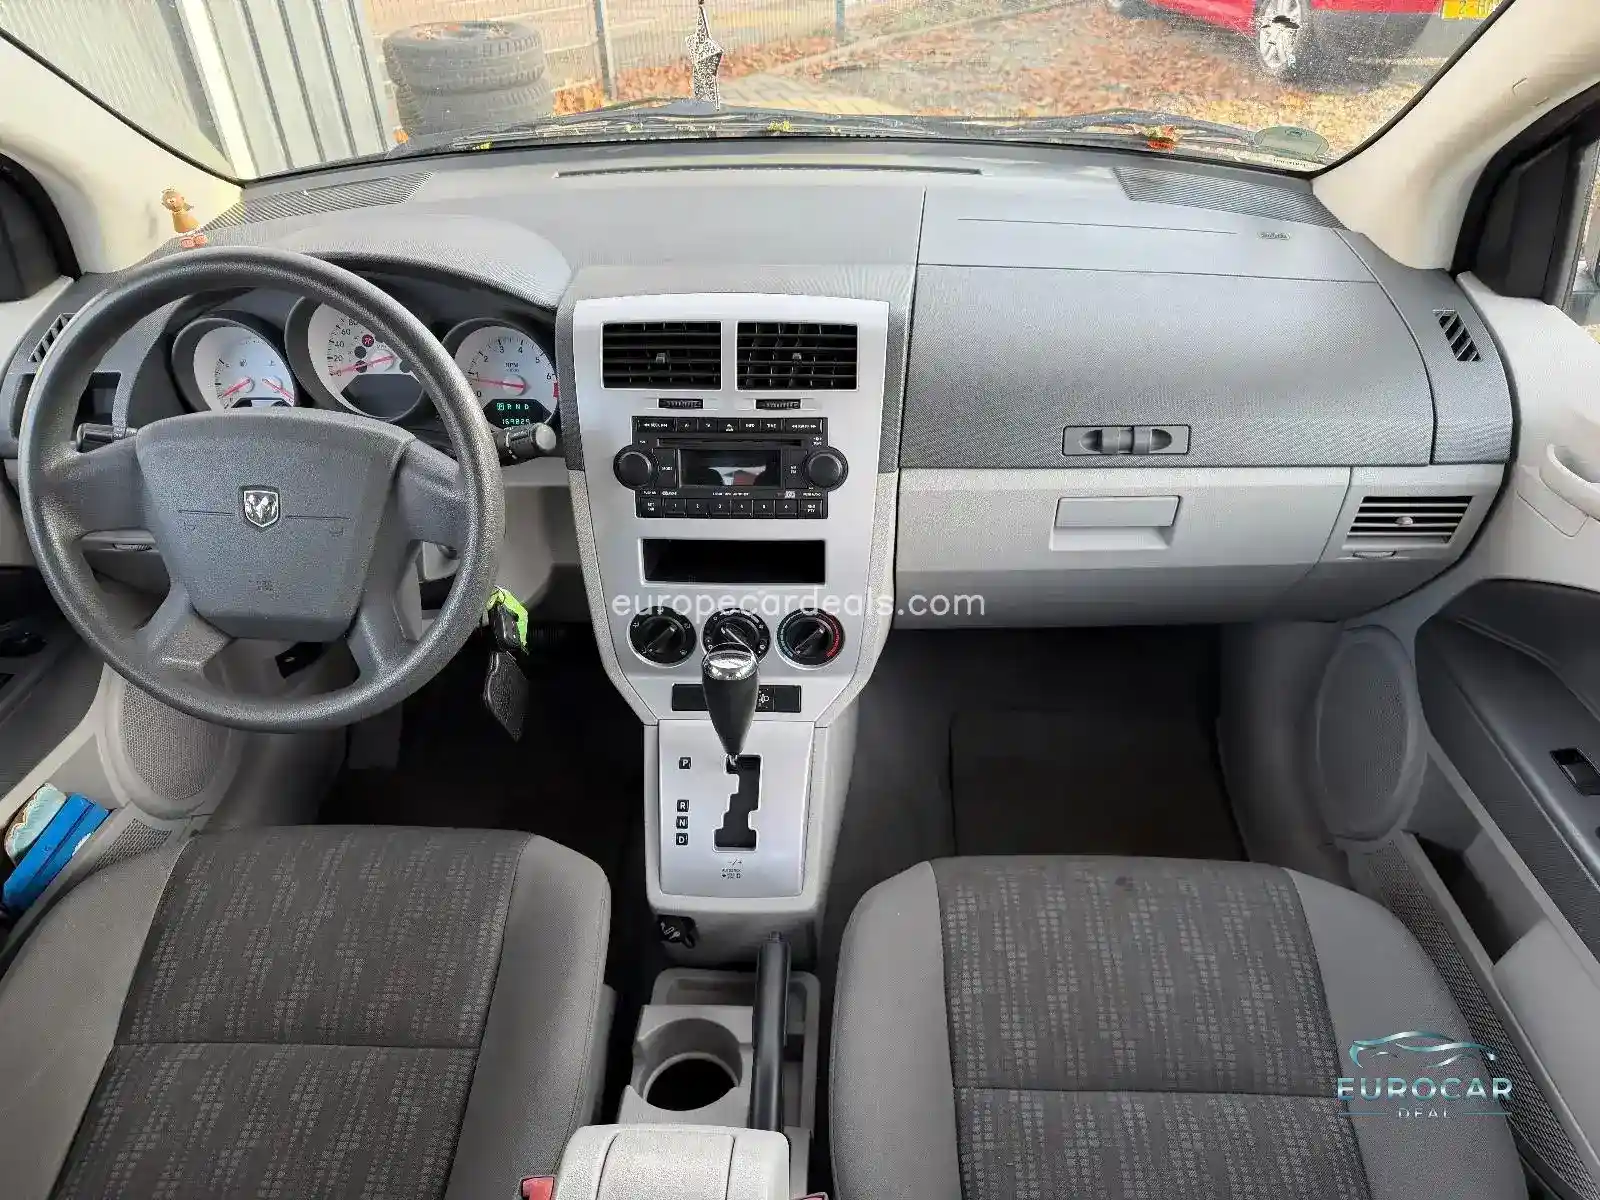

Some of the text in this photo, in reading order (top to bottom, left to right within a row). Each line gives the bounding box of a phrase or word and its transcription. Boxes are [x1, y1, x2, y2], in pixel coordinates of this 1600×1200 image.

[342, 328, 351, 336] 60
[335, 340, 345, 348] 40
[500, 346, 505, 354] 3
[518, 346, 524, 354] 4
[484, 355, 489, 363] 2
[536, 356, 541, 364] 5
